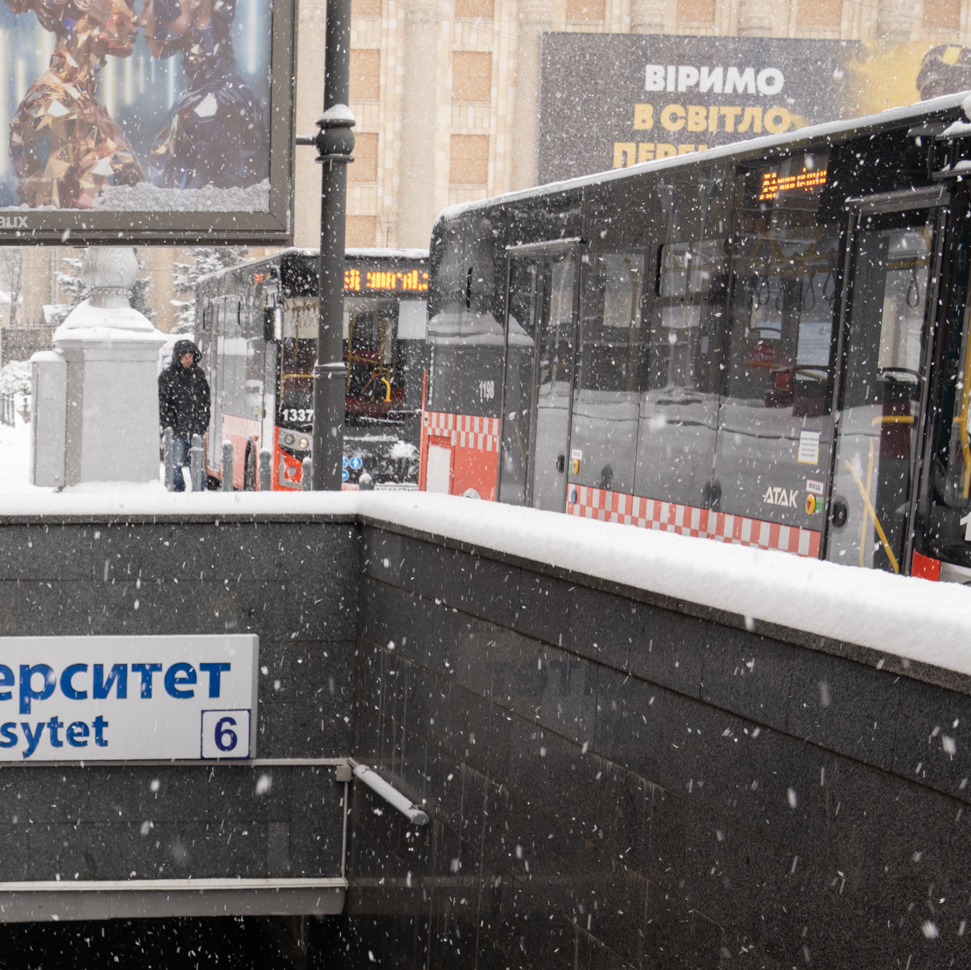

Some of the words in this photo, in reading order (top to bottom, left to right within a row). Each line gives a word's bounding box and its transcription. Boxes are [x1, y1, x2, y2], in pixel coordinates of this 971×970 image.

[645, 64, 785, 96] ВІРИМО
[633, 103, 655, 131] В
[660, 103, 792, 134] СВІТЛО
[282, 408, 314, 422] 1337
[762, 486, 799, 508] ATAK
[212, 718, 239, 752] 6
